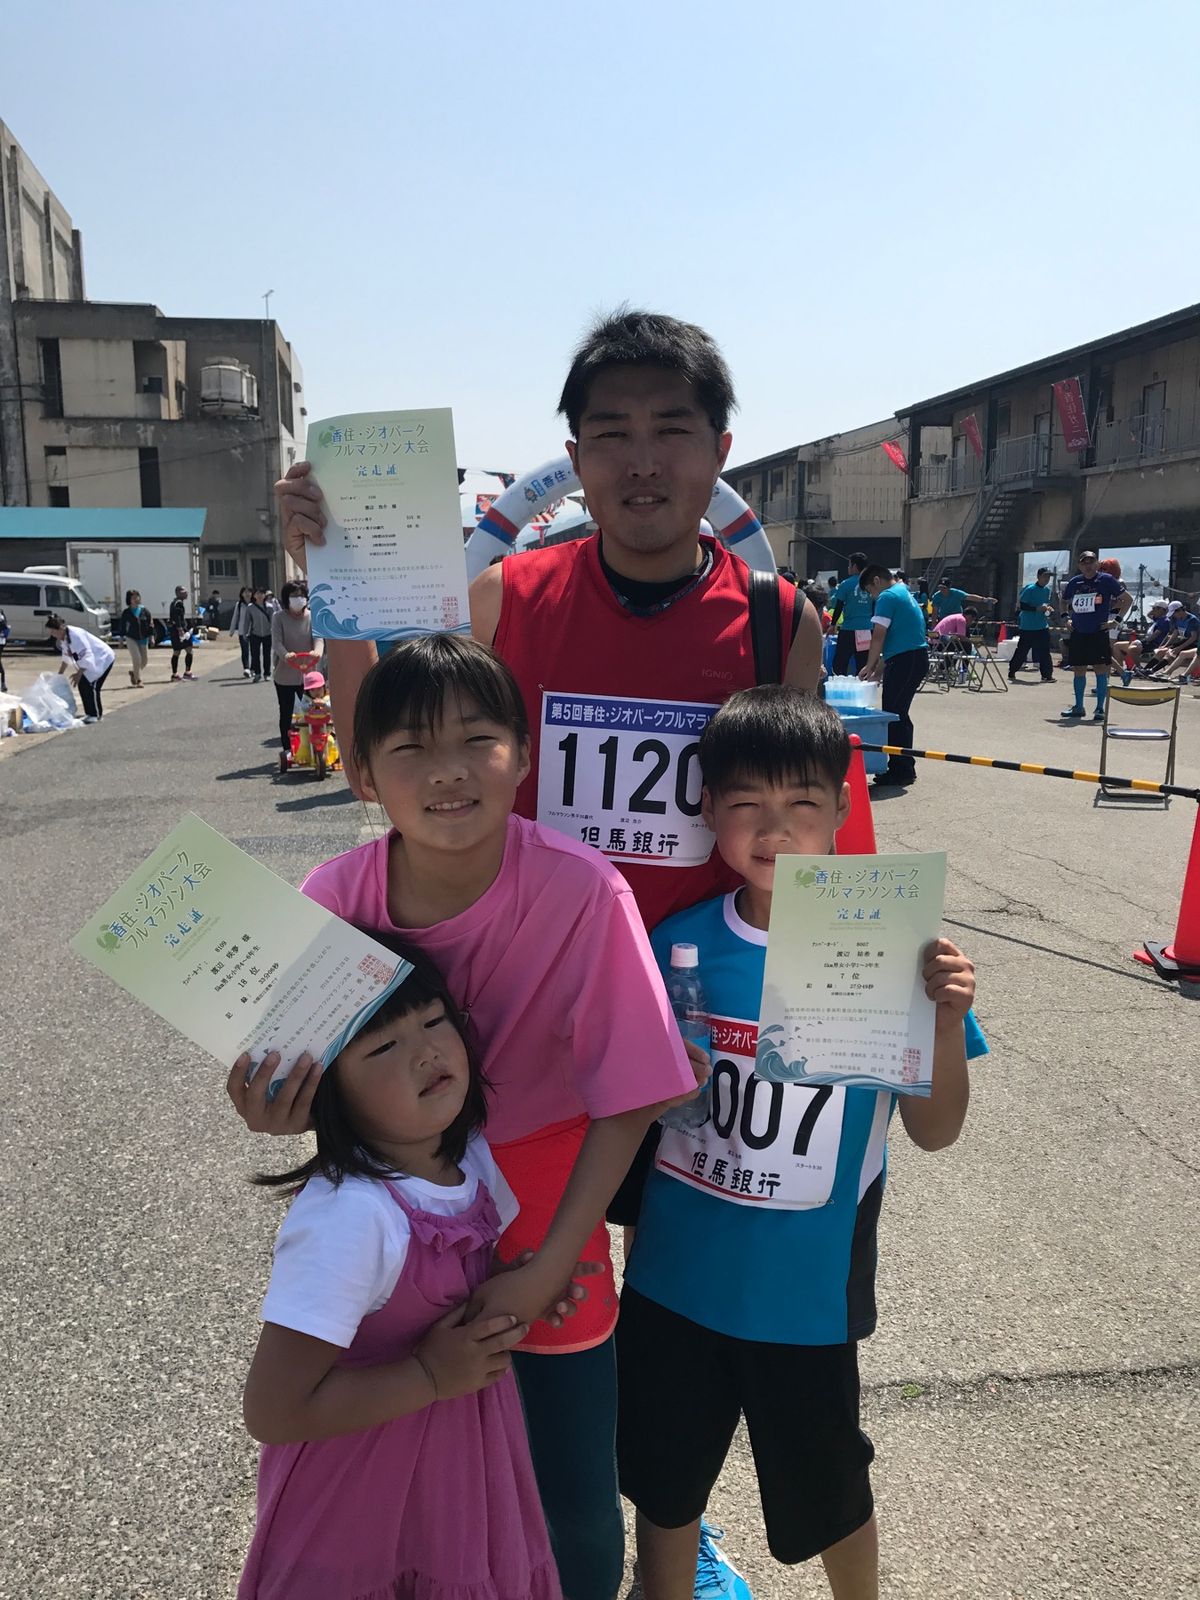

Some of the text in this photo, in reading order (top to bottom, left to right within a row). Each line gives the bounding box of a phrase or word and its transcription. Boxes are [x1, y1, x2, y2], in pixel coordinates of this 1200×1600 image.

[332, 423, 425, 443] 香住・ジオパーク
[333, 439, 429, 458] フルマラソン大会
[551, 702, 712, 730] 第5回香住・ジオパークフルマラ
[558, 732, 704, 817] 1120
[580, 826, 680, 857] 但馬銀行
[815, 867, 920, 885] 香住・ジオパーク
[108, 850, 191, 939] 香住・ジオパーク
[125, 859, 214, 949] フルマラソン大会
[815, 883, 920, 900] フルマラソン大会
[163, 907, 205, 949] 完走証
[837, 908, 881, 920] 完走証
[237, 965, 261, 989] 18 位
[692, 1151, 782, 1198] 但馬銀行
